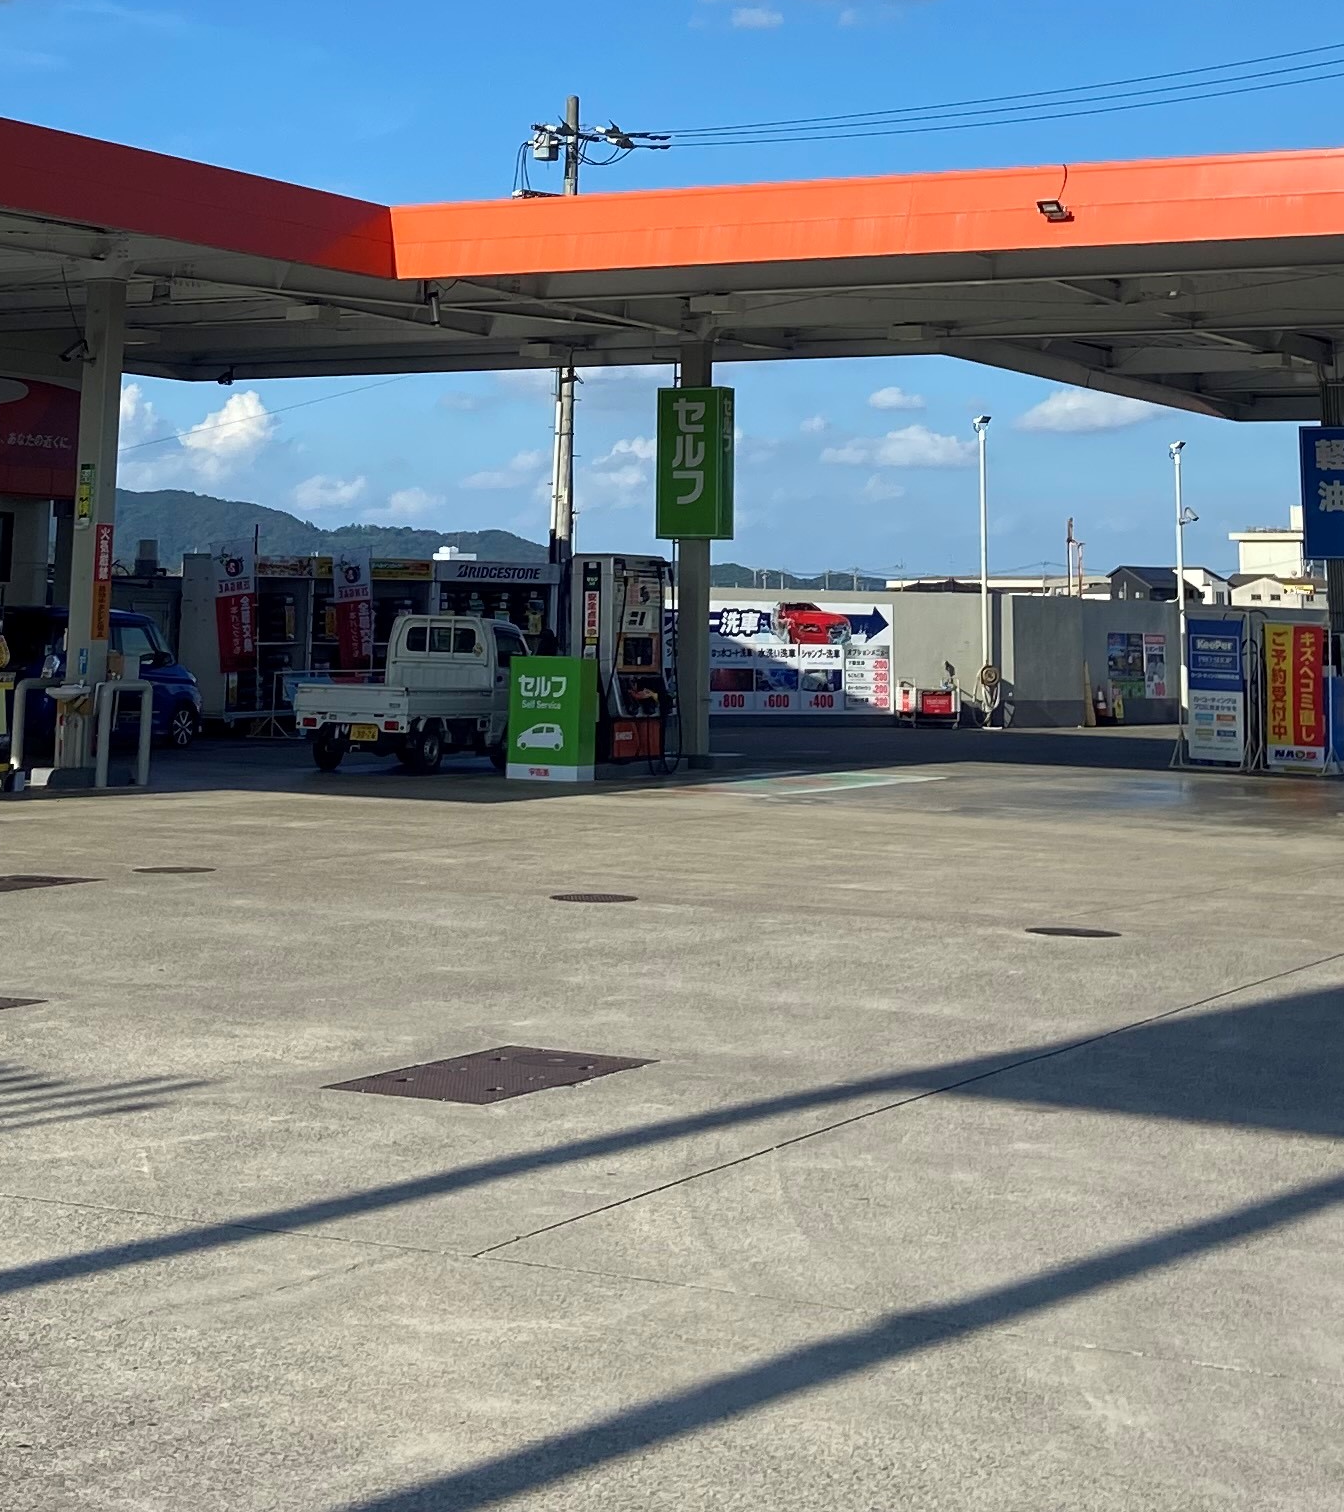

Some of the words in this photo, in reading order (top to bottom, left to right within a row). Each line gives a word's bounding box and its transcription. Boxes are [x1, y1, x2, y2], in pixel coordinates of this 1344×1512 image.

[672, 398, 705, 505] セルフ
[457, 565, 541, 579] BRIDGESTONE
[1196, 639, 1233, 650] KeePer
[758, 648, 796, 658] 水洗い洗車
[802, 649, 840, 658] シャンプー洗車
[518, 674, 567, 697] セルフ
[1271, 632, 1288, 740] ご予約受付中
[1299, 632, 1316, 742] キズ・ヘコミ直し
[521, 699, 535, 708] Self
[536, 699, 561, 709] Service
